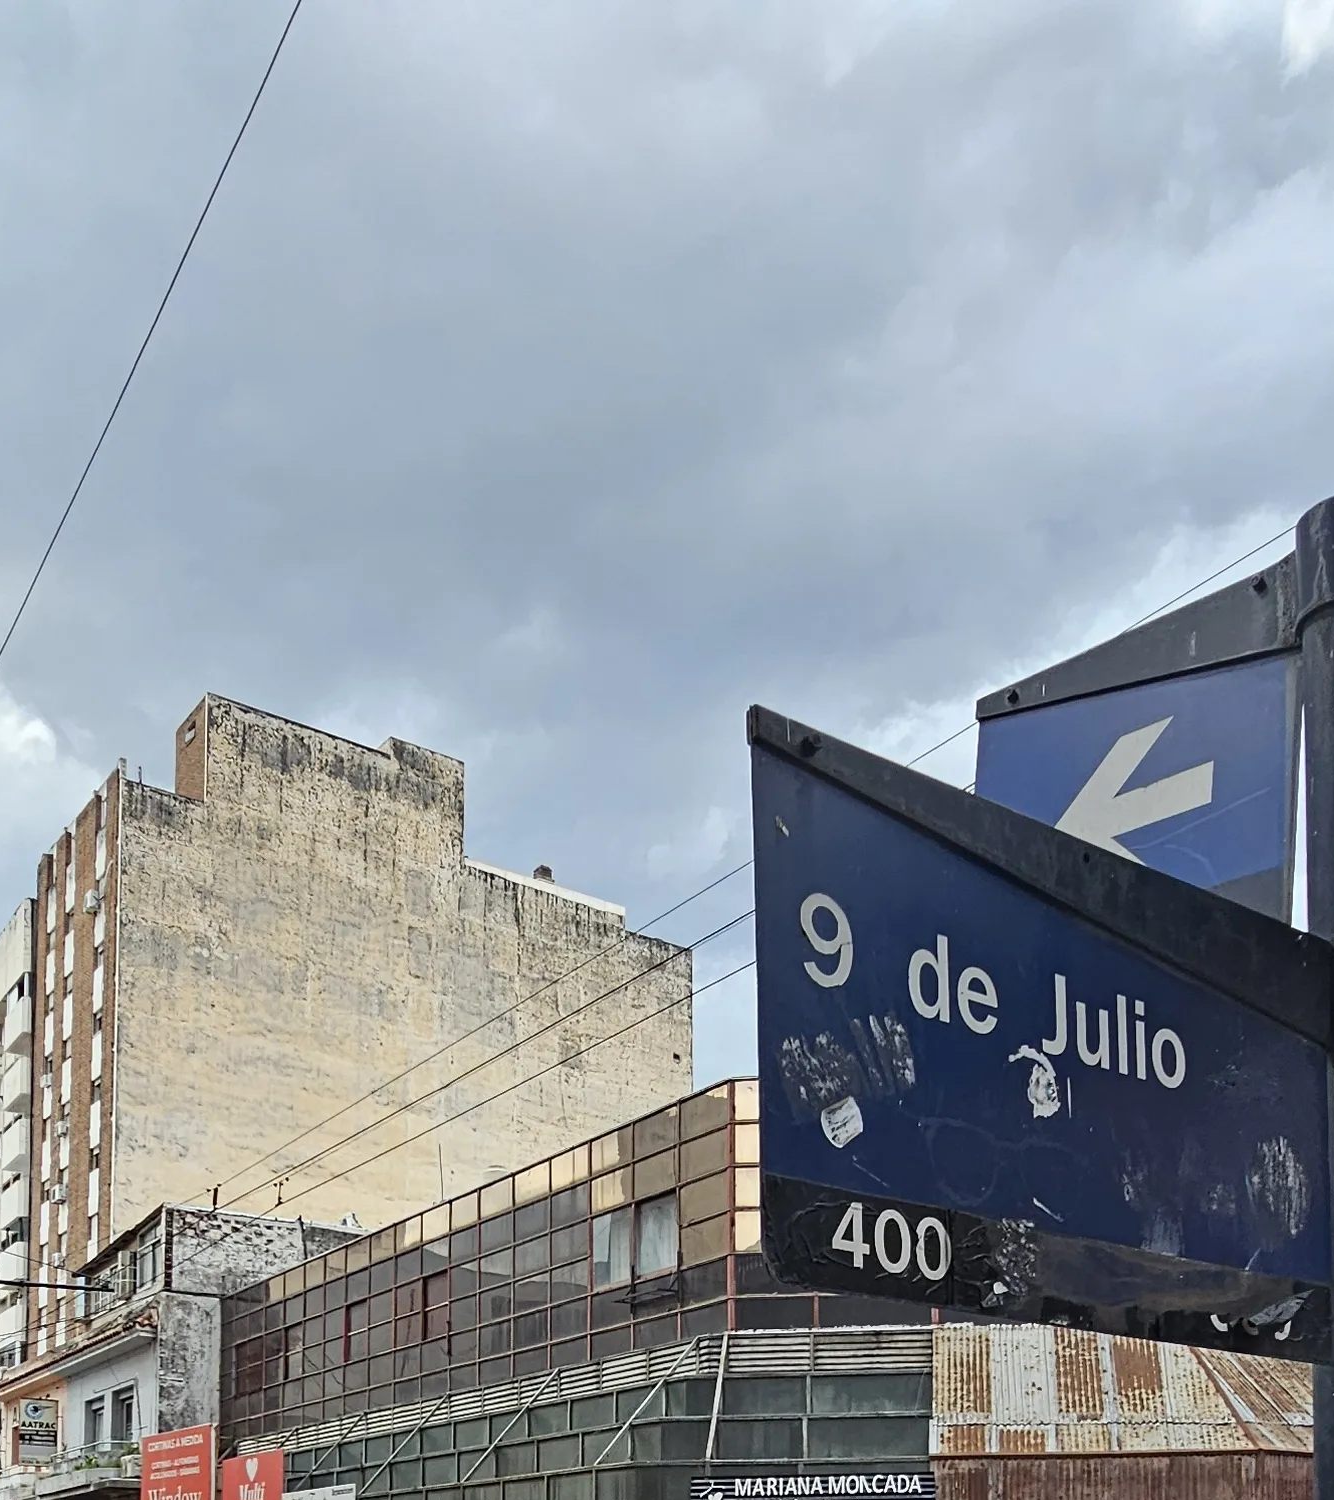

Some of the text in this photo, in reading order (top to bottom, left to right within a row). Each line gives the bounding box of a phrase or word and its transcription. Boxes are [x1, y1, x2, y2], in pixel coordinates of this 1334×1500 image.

[800, 892, 1186, 1089] 9 de Julio
[832, 1202, 952, 1281] 400
[734, 1475, 922, 1497] MARIANA MONCADA
